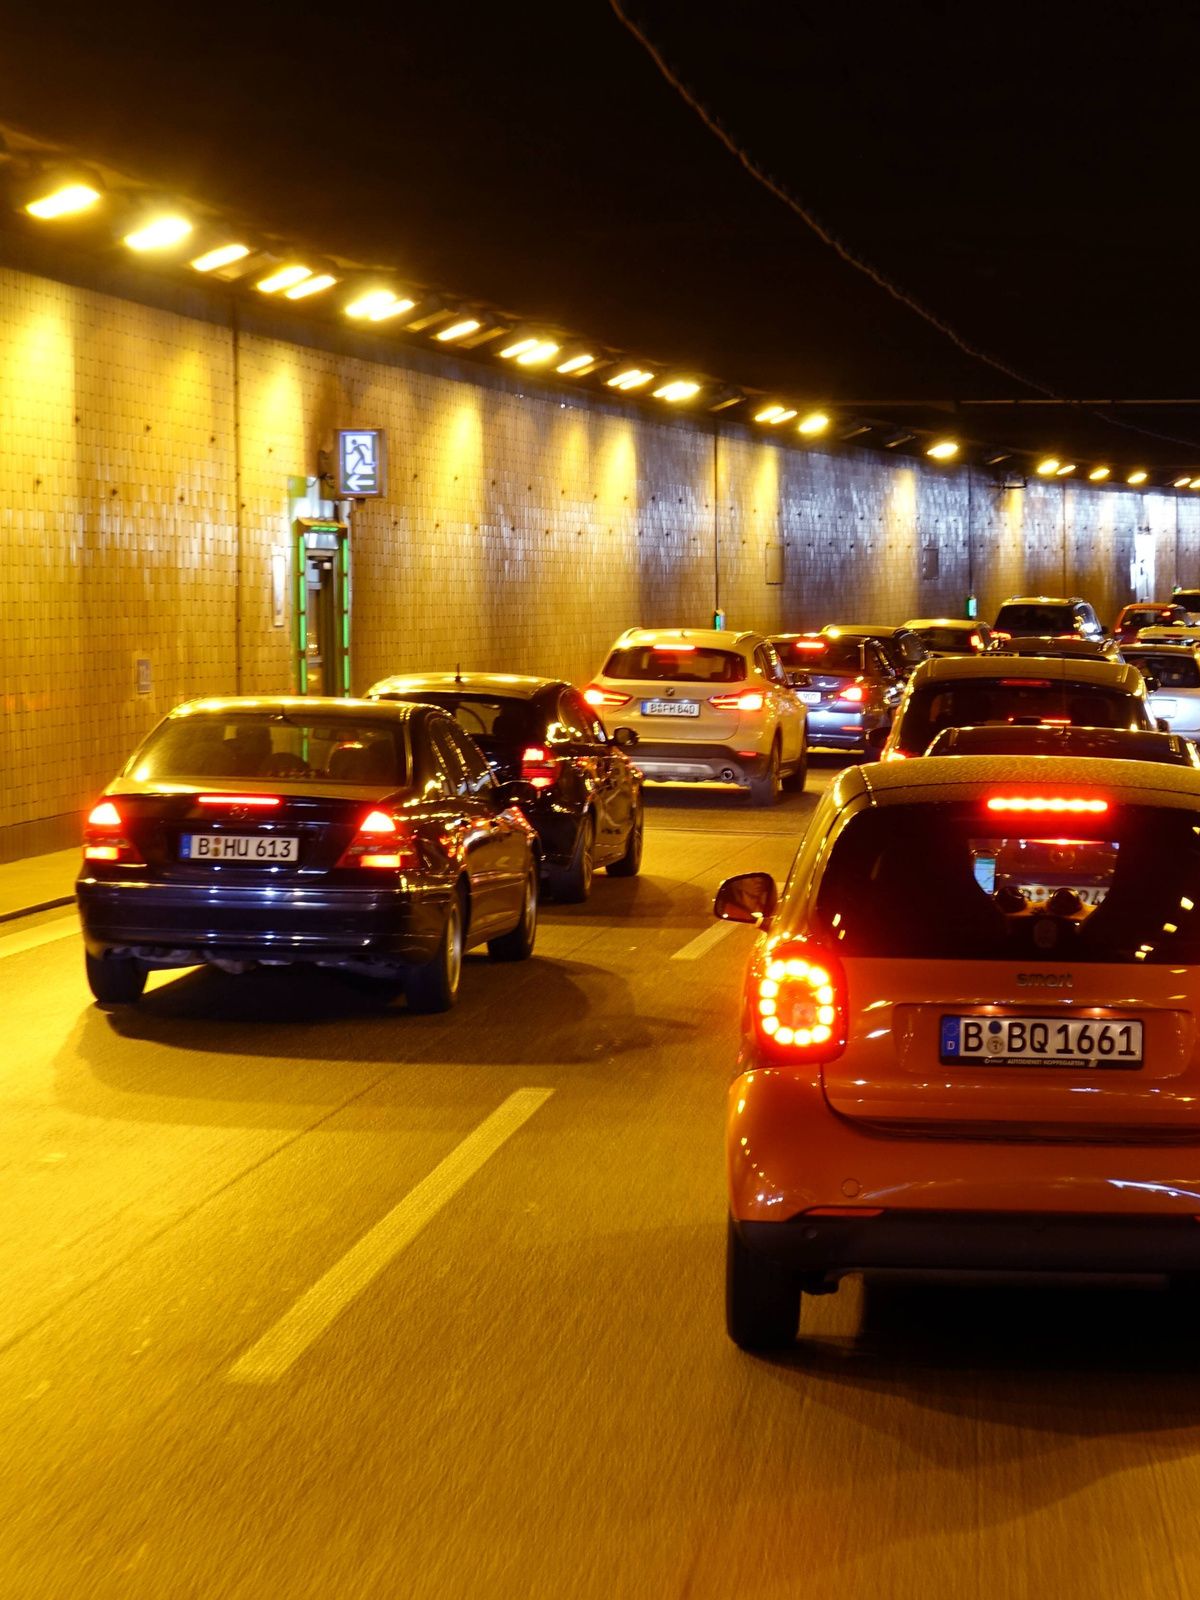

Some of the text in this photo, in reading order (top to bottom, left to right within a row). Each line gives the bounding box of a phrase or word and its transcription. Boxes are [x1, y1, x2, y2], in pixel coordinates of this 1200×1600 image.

[198, 838, 210, 855] B
[223, 839, 250, 856] HU
[255, 840, 291, 857] 613
[963, 1022, 984, 1053] B
[1007, 1022, 1049, 1054] BQ
[1055, 1023, 1136, 1056] 1661
